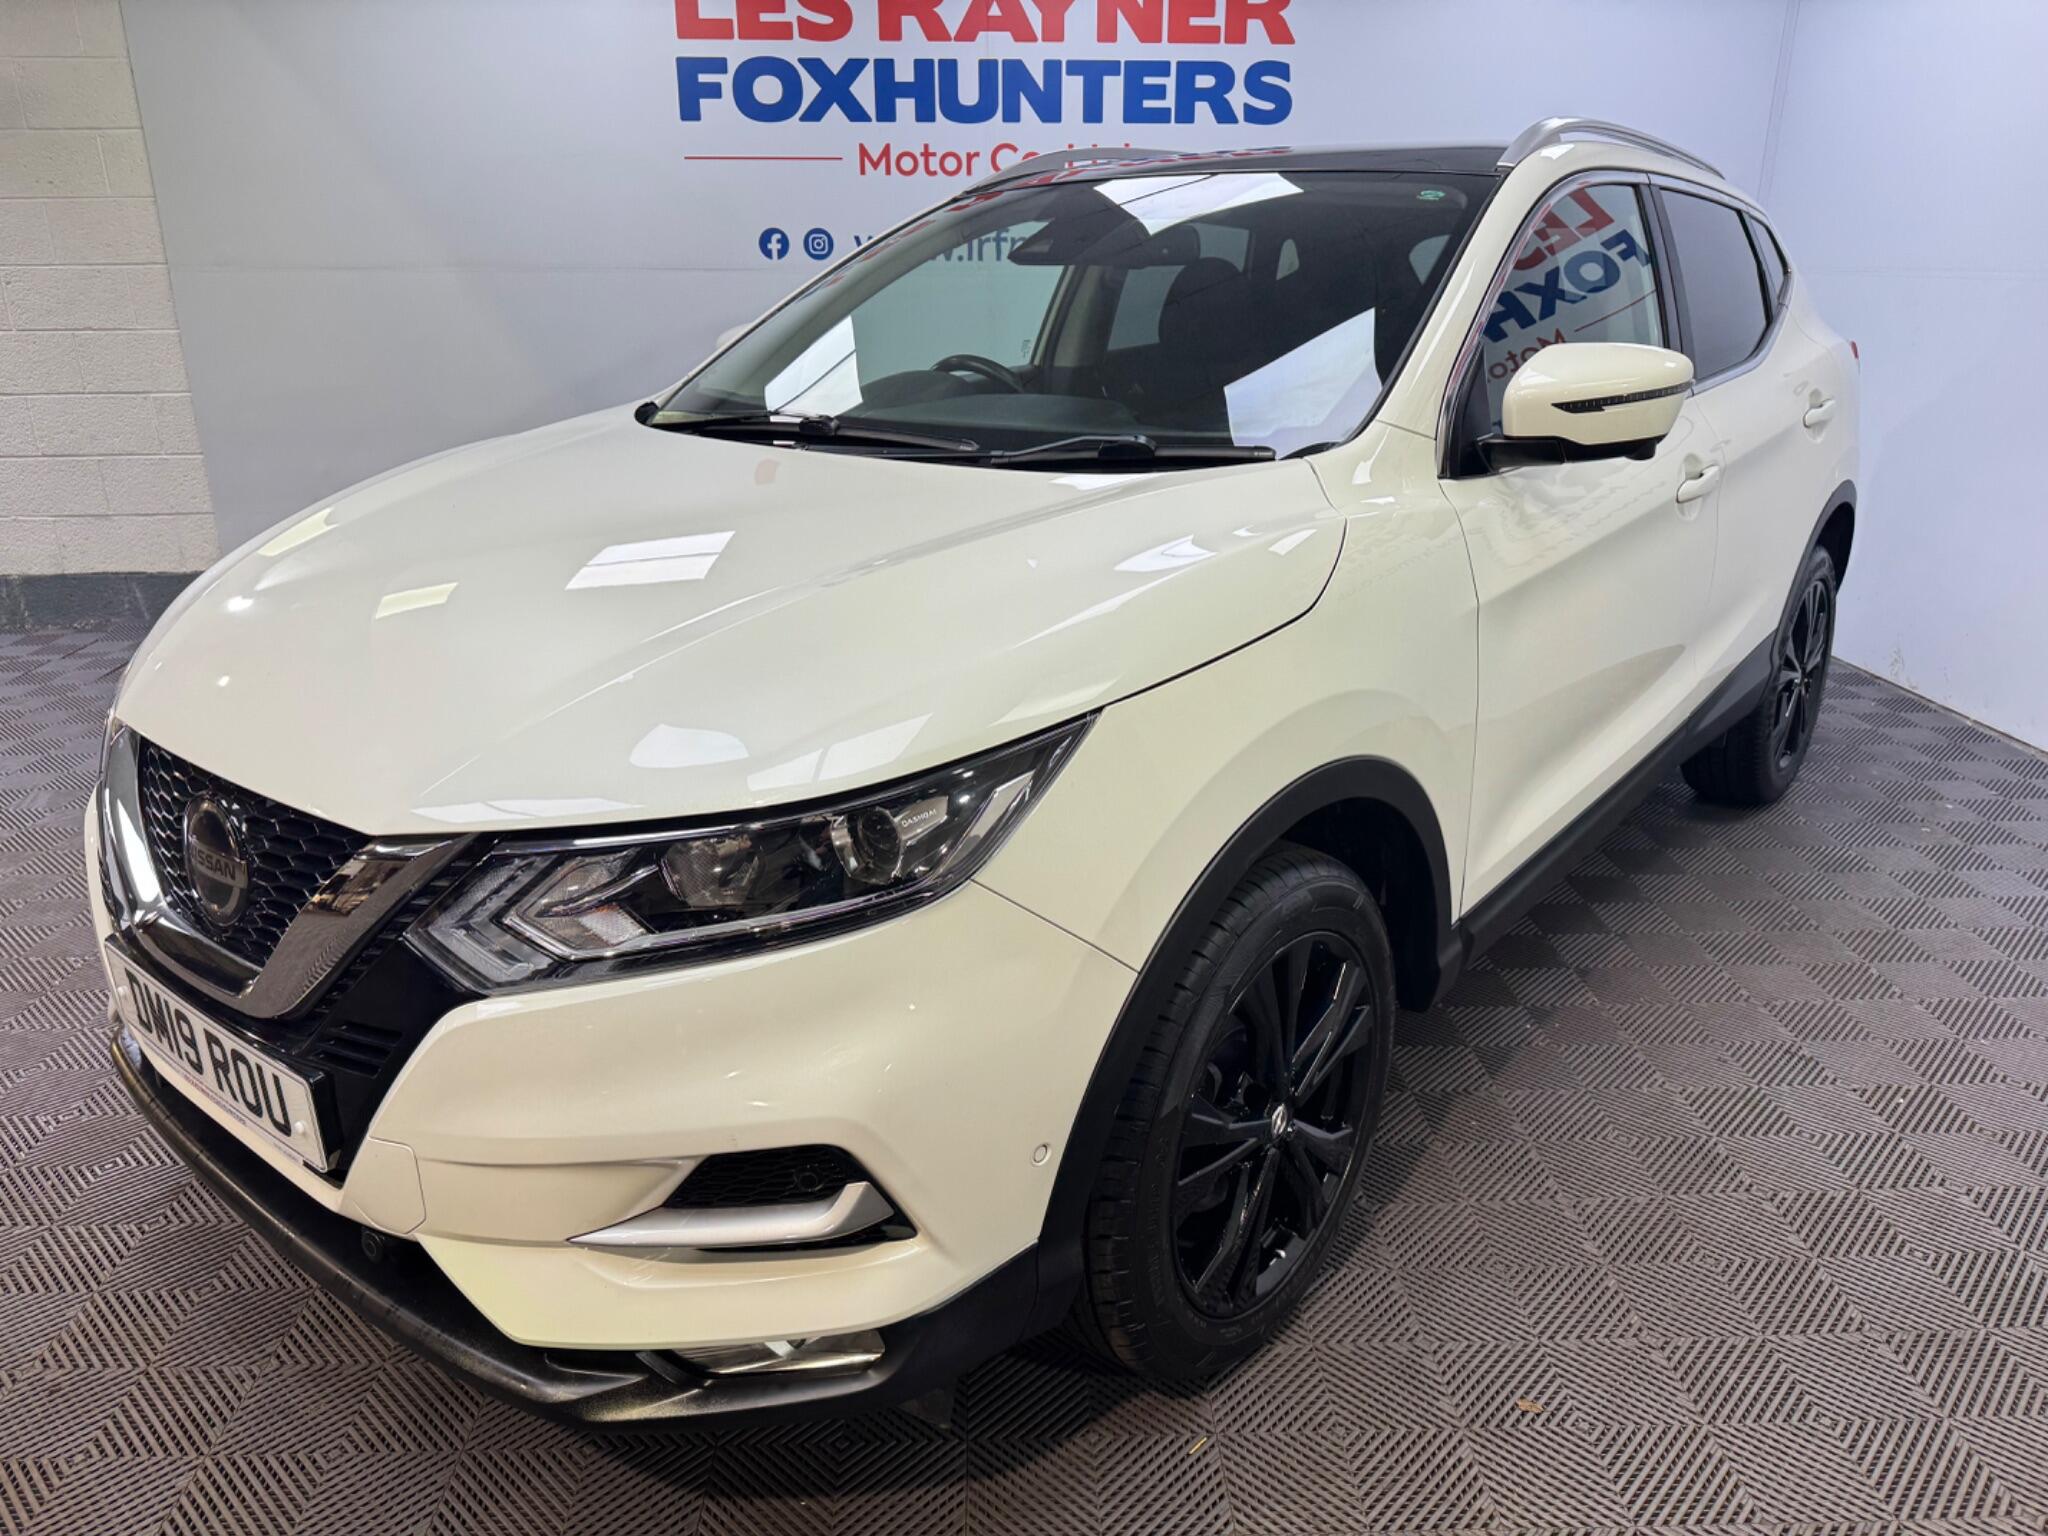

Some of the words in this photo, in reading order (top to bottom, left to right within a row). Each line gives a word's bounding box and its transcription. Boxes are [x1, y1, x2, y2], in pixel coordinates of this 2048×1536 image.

[676, 0, 853, 41] LES
[878, 0, 1296, 44] RAYNER
[676, 56, 1293, 126] FOXHUNTERS
[859, 143, 979, 176] Motor
[125, 967, 203, 1075] DM19
[203, 1027, 291, 1138] ROU
